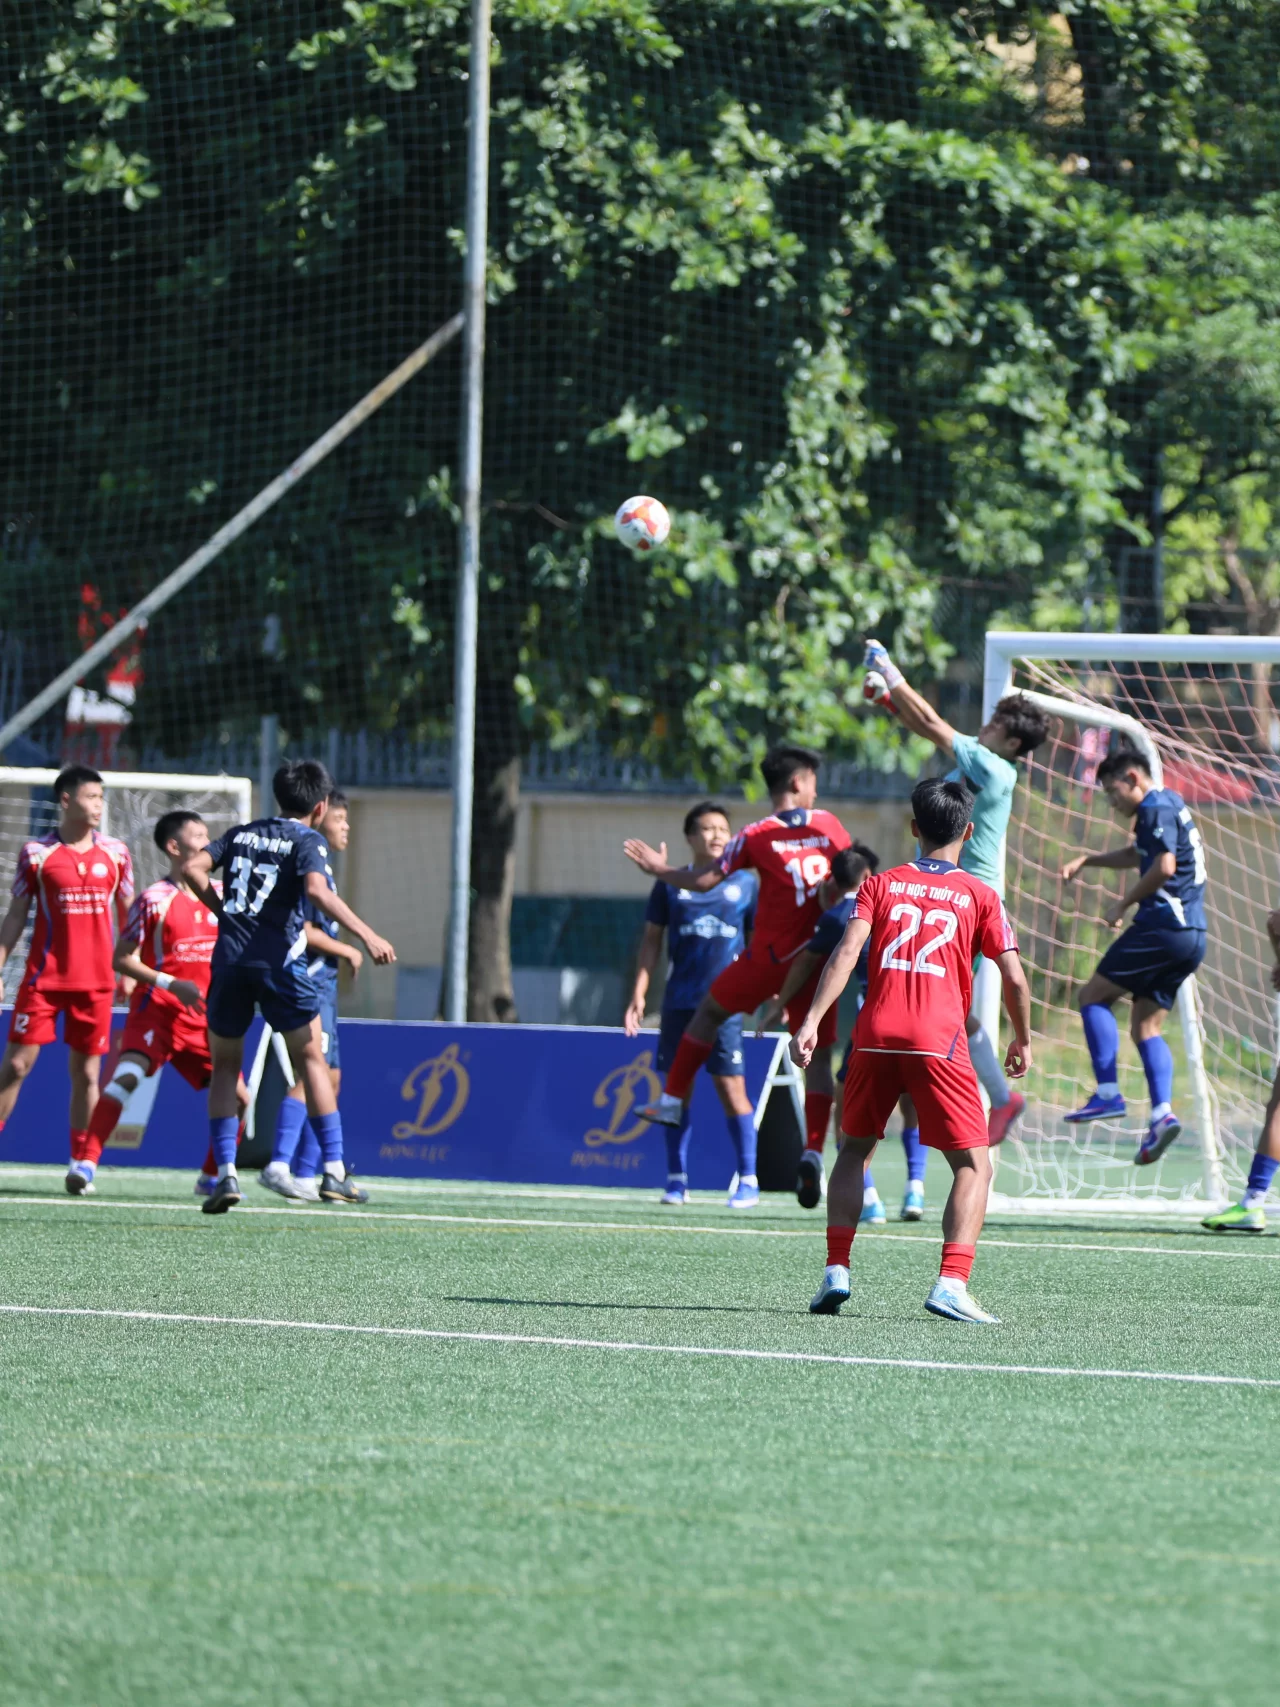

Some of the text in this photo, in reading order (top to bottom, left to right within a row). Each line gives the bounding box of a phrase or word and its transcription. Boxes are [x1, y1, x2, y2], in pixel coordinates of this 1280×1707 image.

[223, 856, 279, 917] 37
[889, 881, 971, 909] ĐẠI HỌC THỦY LỢI
[881, 903, 958, 978] 22
[143, 1028, 156, 1047] 4
